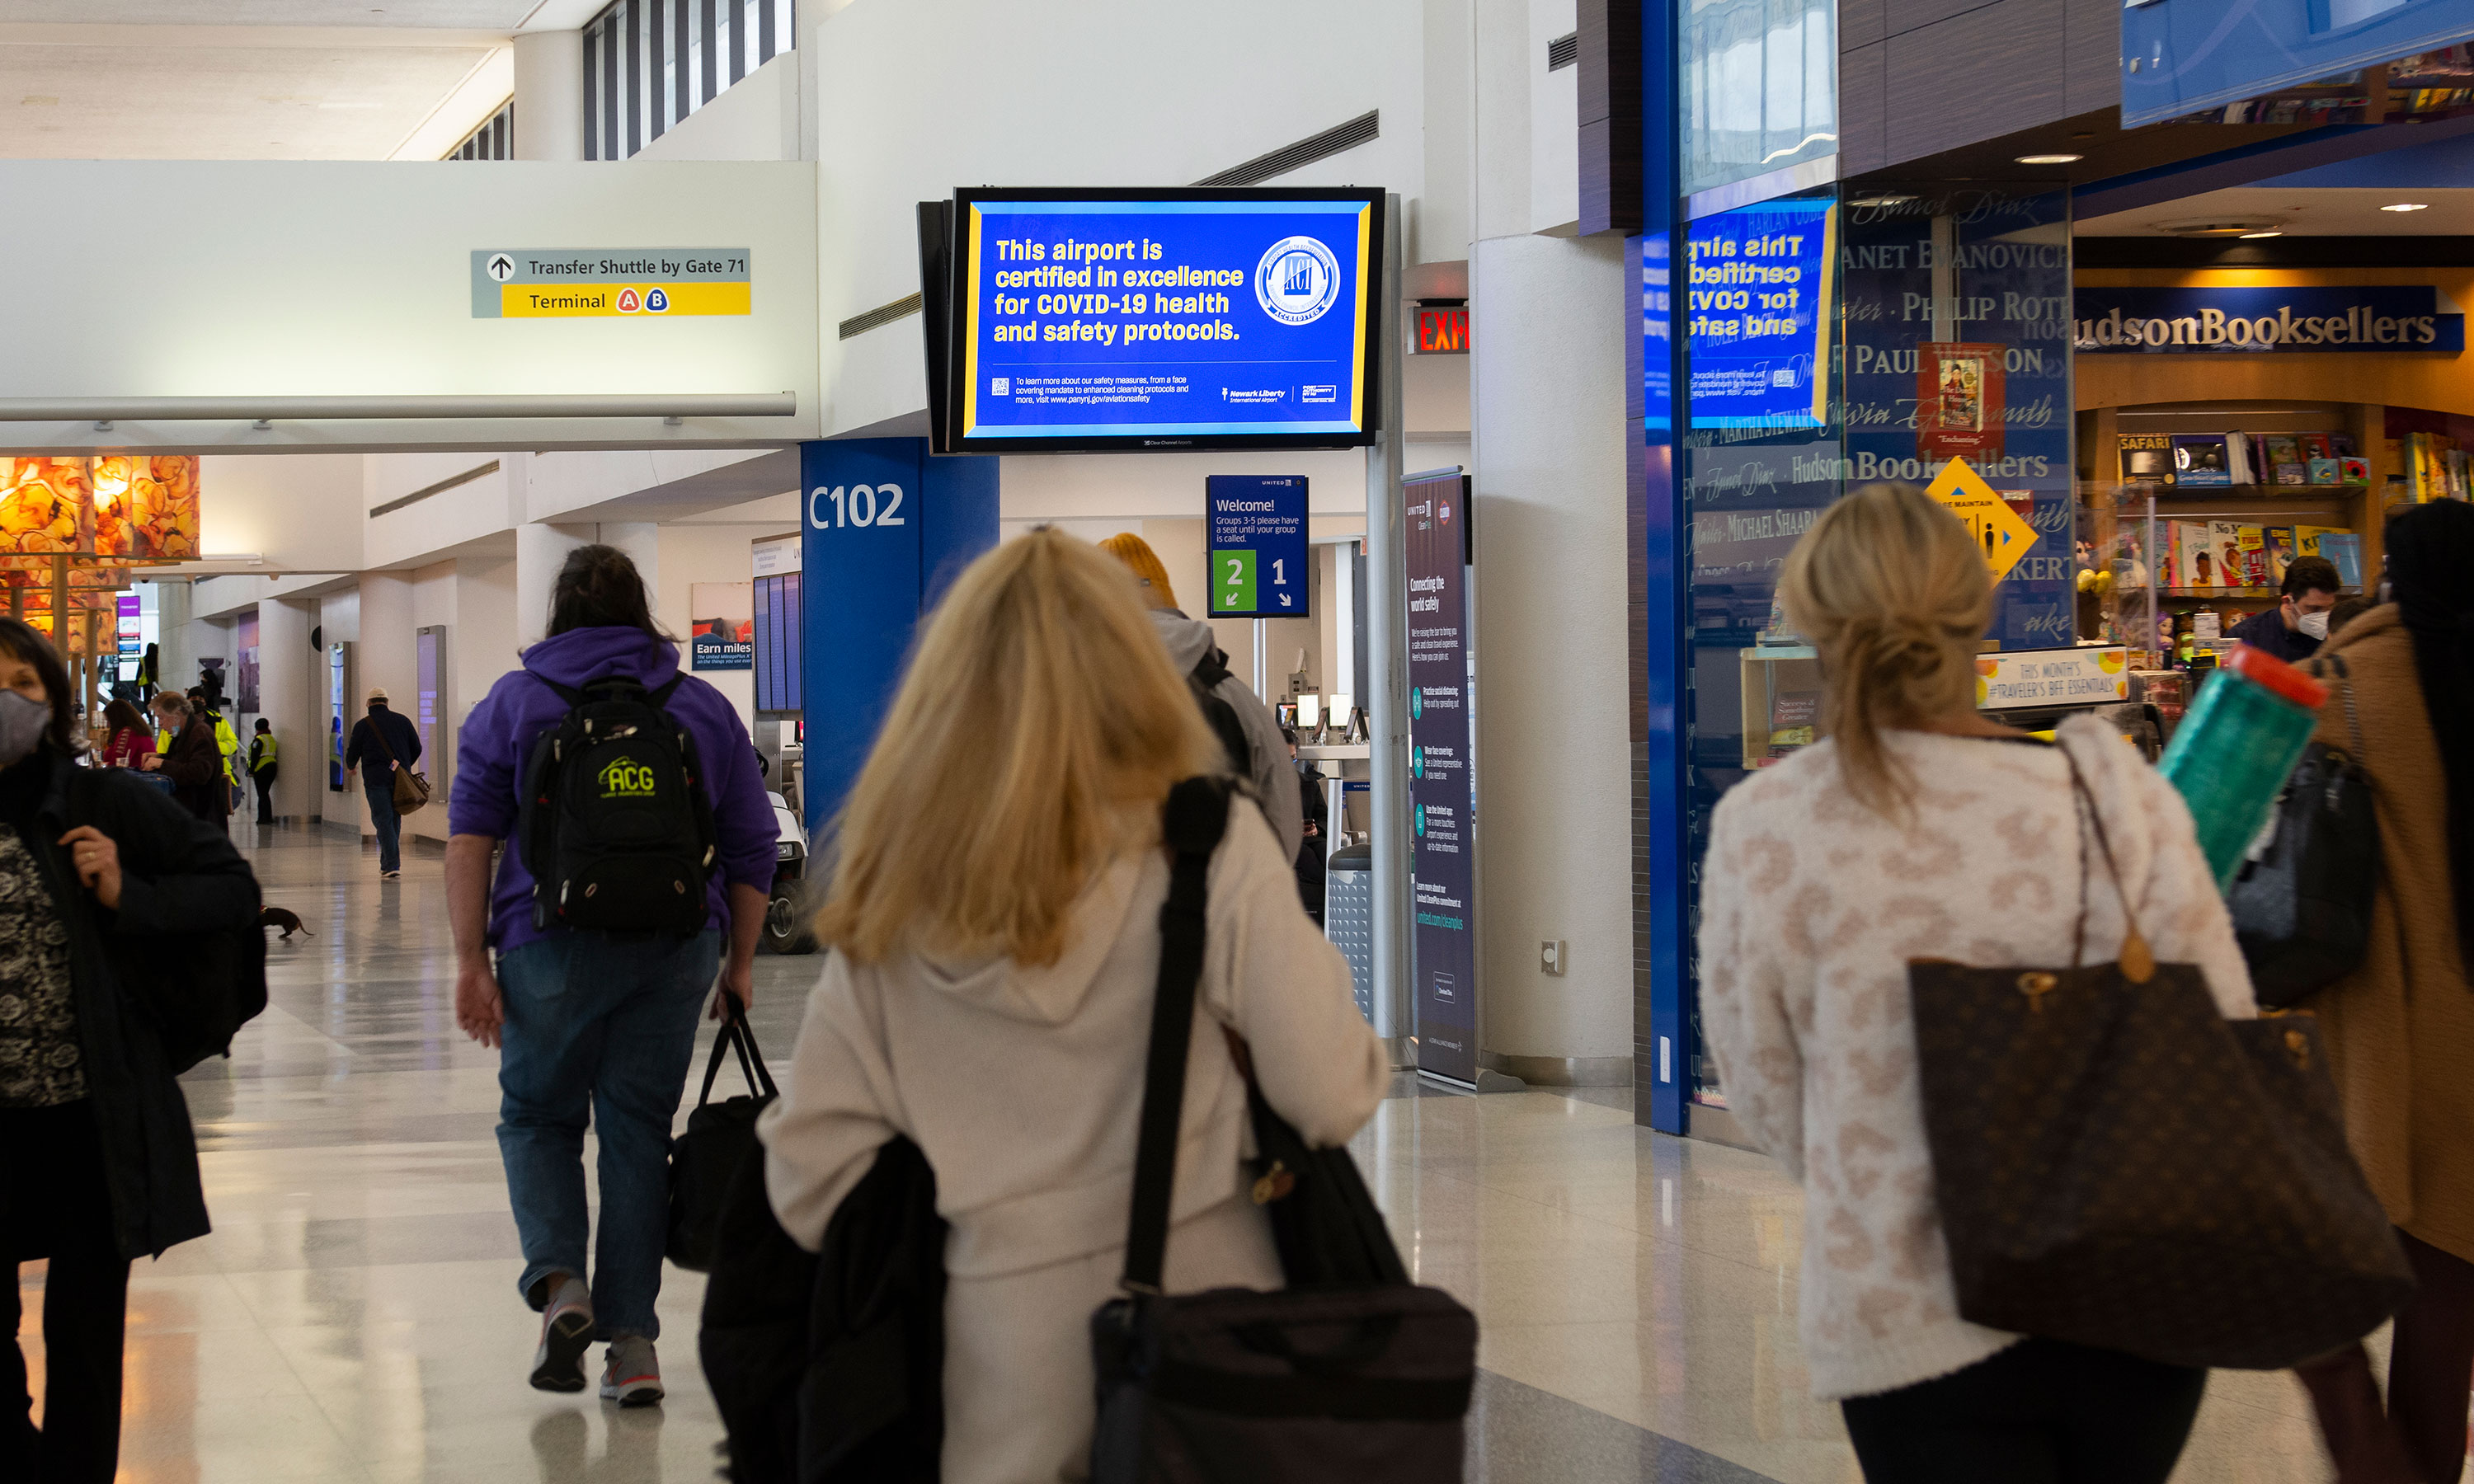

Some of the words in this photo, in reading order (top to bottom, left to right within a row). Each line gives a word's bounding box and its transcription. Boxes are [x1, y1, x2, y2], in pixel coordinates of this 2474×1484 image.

[996, 239, 1045, 261] This
[1052, 238, 1135, 265] airport
[1143, 238, 1162, 260] is
[529, 260, 595, 275] Transfer
[600, 259, 656, 274] Shuttle
[661, 258, 680, 277] by
[685, 259, 722, 273] Gate
[728, 259, 744, 273] 71
[995, 265, 1091, 288] certified
[1098, 265, 1117, 287] in
[1123, 265, 1244, 286] excellence
[1285, 257, 1312, 290] ACI
[529, 294, 605, 309] Terminal
[623, 294, 635, 308] A
[652, 293, 662, 308] B
[995, 293, 1030, 315] for
[1037, 294, 1147, 314] COVID-19
[1155, 293, 1230, 313] health
[1274, 309, 1320, 322] ACCREDITED
[994, 321, 1037, 341] and
[1043, 320, 1117, 346] safety
[1123, 319, 1240, 345] protocols.
[1856, 345, 1927, 374] PAUL
[1016, 377, 1024, 385] To
[1025, 377, 1042, 385] learn
[1061, 377, 1081, 385] about
[1094, 377, 1114, 386] safety
[1115, 377, 1149, 385] measures,
[1150, 376, 1165, 384] from
[1015, 387, 1044, 396] covering
[1045, 386, 1074, 394] mandate
[1084, 386, 1116, 394] enhanced
[1117, 385, 1144, 395] cleaning
[1145, 385, 1175, 394] protocols
[1258, 389, 1286, 398] Liberty
[1015, 396, 1035, 405] more,
[1036, 395, 1049, 404] visit
[1051, 395, 1150, 405] www.panynj.gov/aviationsafety
[1719, 416, 1763, 444] MARTHA
[1765, 408, 1814, 437] STEWART
[2120, 437, 2171, 449] SAFARI
[809, 483, 905, 529] C102
[1216, 499, 1275, 512] Welcome!
[1407, 505, 1426, 516] UNITED
[1216, 516, 1242, 526] Groups
[1244, 516, 1256, 524] 3-5
[1257, 516, 1281, 526] please
[1281, 516, 1300, 524] have
[1222, 525, 1238, 533] seat
[1239, 525, 1255, 533] until
[1257, 526, 1273, 535] your
[1275, 526, 1296, 534] group
[1727, 514, 1774, 542] MICHAEL
[1216, 534, 1223, 542] is
[1224, 534, 1247, 542] called.
[1226, 559, 1243, 585] 2
[1272, 558, 1286, 585] 1
[1410, 576, 1437, 593] Connecting
[1437, 575, 1445, 590] the
[1410, 597, 1424, 613] world
[1425, 596, 1439, 613] safely
[697, 644, 721, 654] Earn
[723, 643, 751, 654] miles
[2020, 664, 2038, 679] THIS
[2043, 661, 2081, 678] MONTH'S
[1989, 681, 2046, 699] #TRAVELER'S
[2048, 680, 2064, 696] BFF
[2068, 678, 2114, 695] ESSENTIALS
[609, 766, 655, 791] ACG
